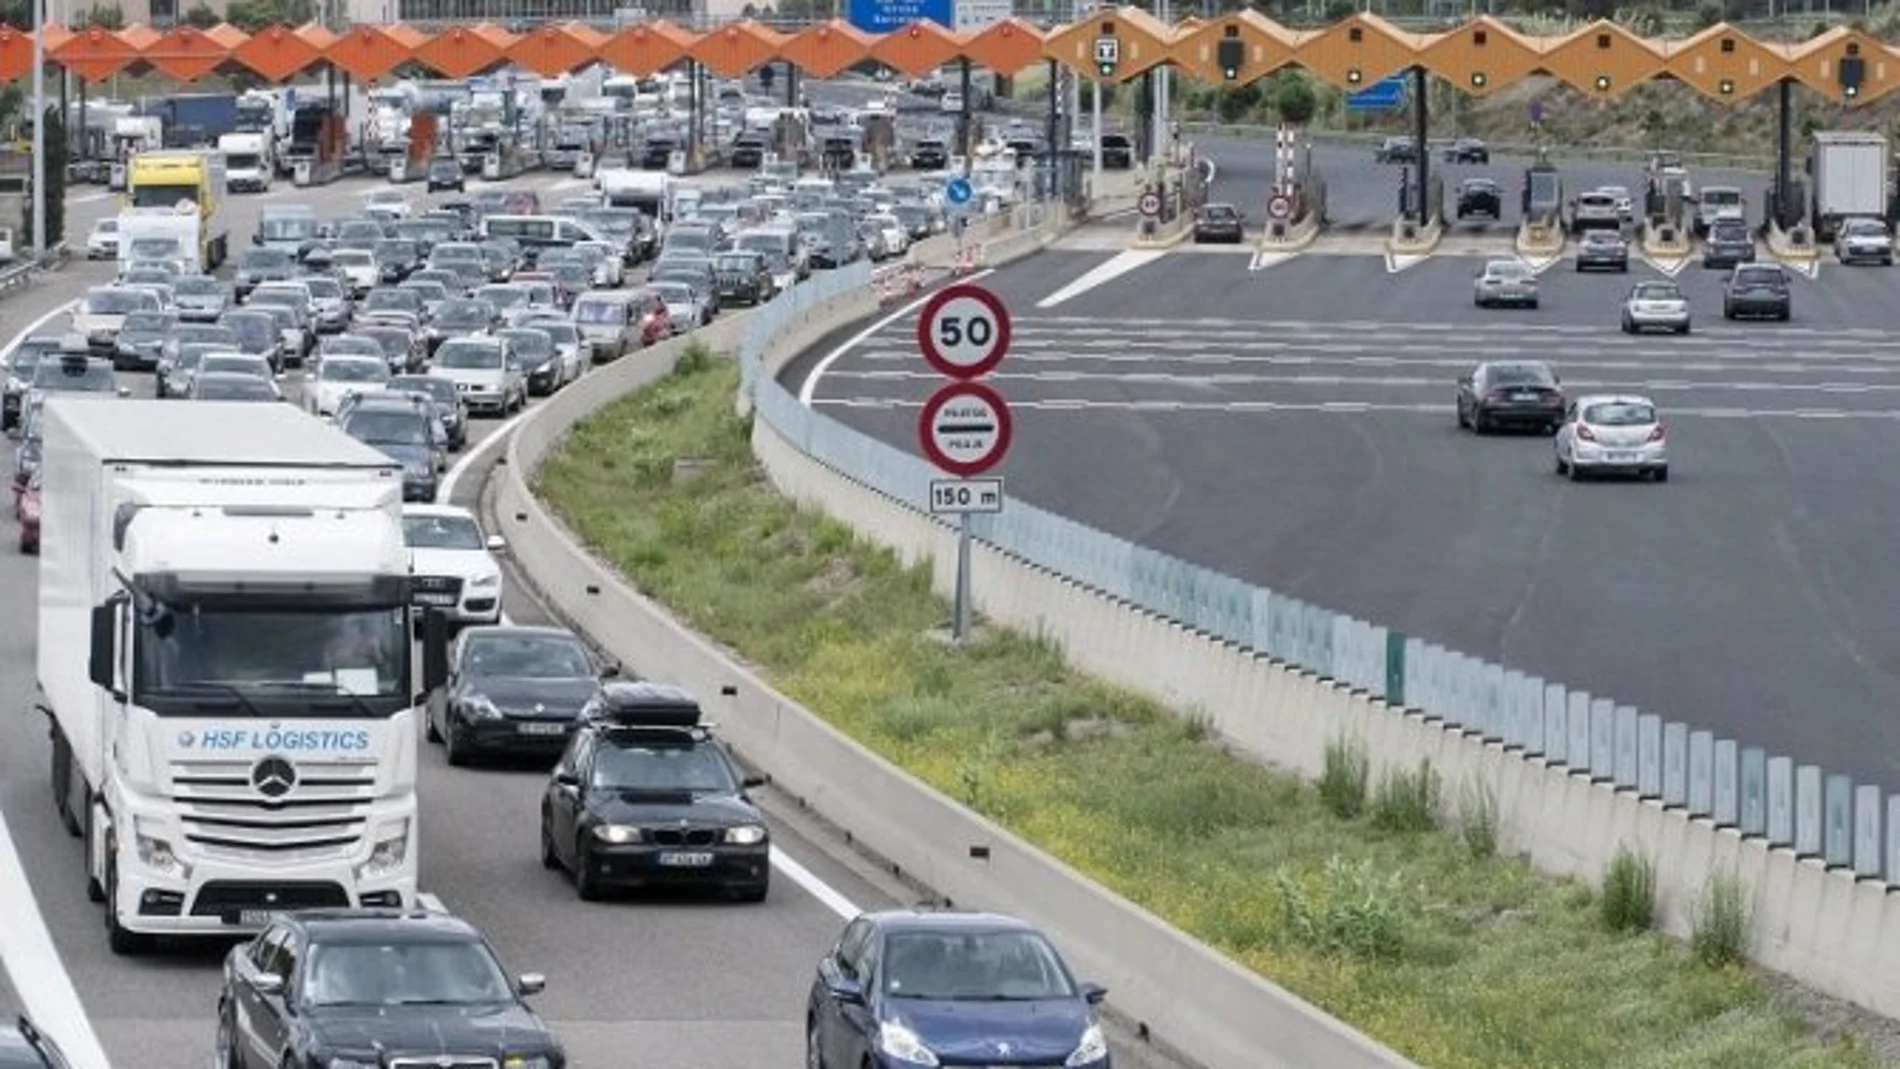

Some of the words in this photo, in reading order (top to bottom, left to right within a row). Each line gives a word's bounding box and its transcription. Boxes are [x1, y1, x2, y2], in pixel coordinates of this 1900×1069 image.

[941, 316, 991, 346] 50
[935, 487, 971, 505] 150
[981, 492, 996, 505] m
[202, 731, 246, 748] HSF
[252, 731, 369, 749] LOGISTICS
